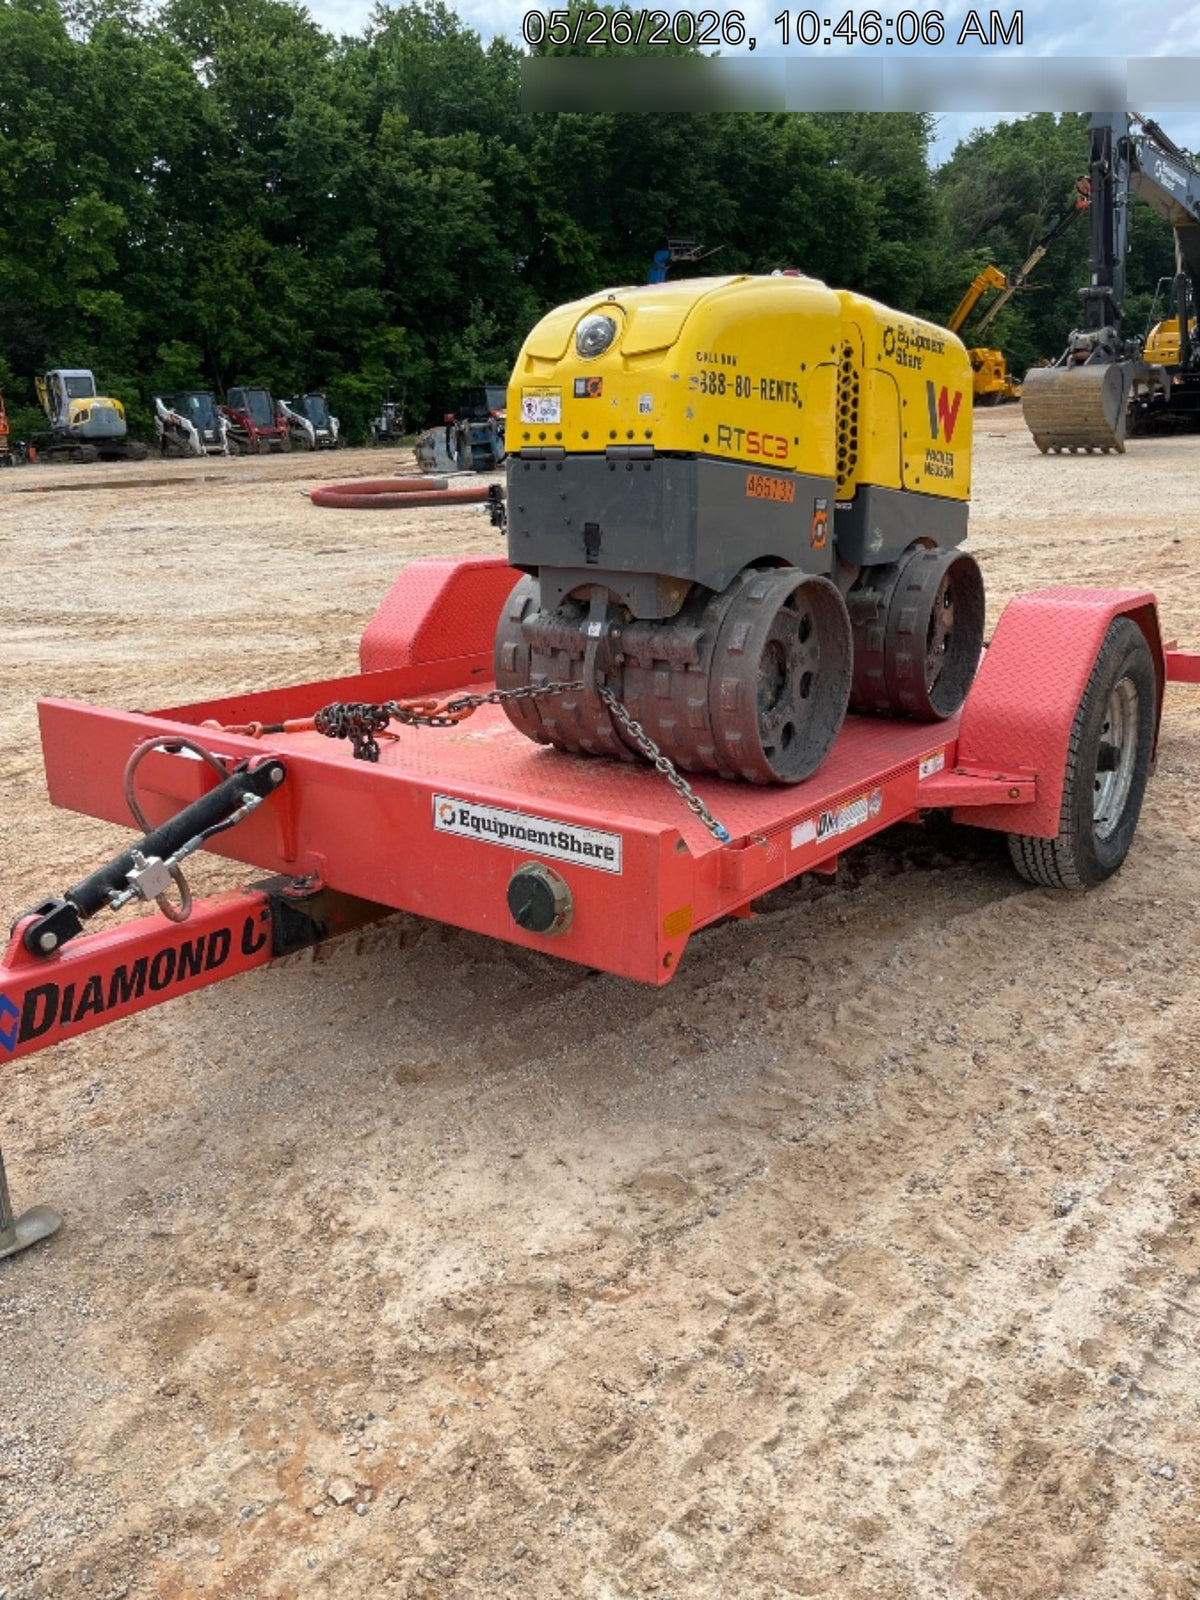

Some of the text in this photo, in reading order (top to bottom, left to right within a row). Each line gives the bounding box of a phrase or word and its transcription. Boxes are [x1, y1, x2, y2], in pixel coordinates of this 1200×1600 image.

[717, 424, 789, 460] RTSC3
[458, 808, 615, 861] EquipmentShare
[18, 909, 271, 1045] DIAMOND C
